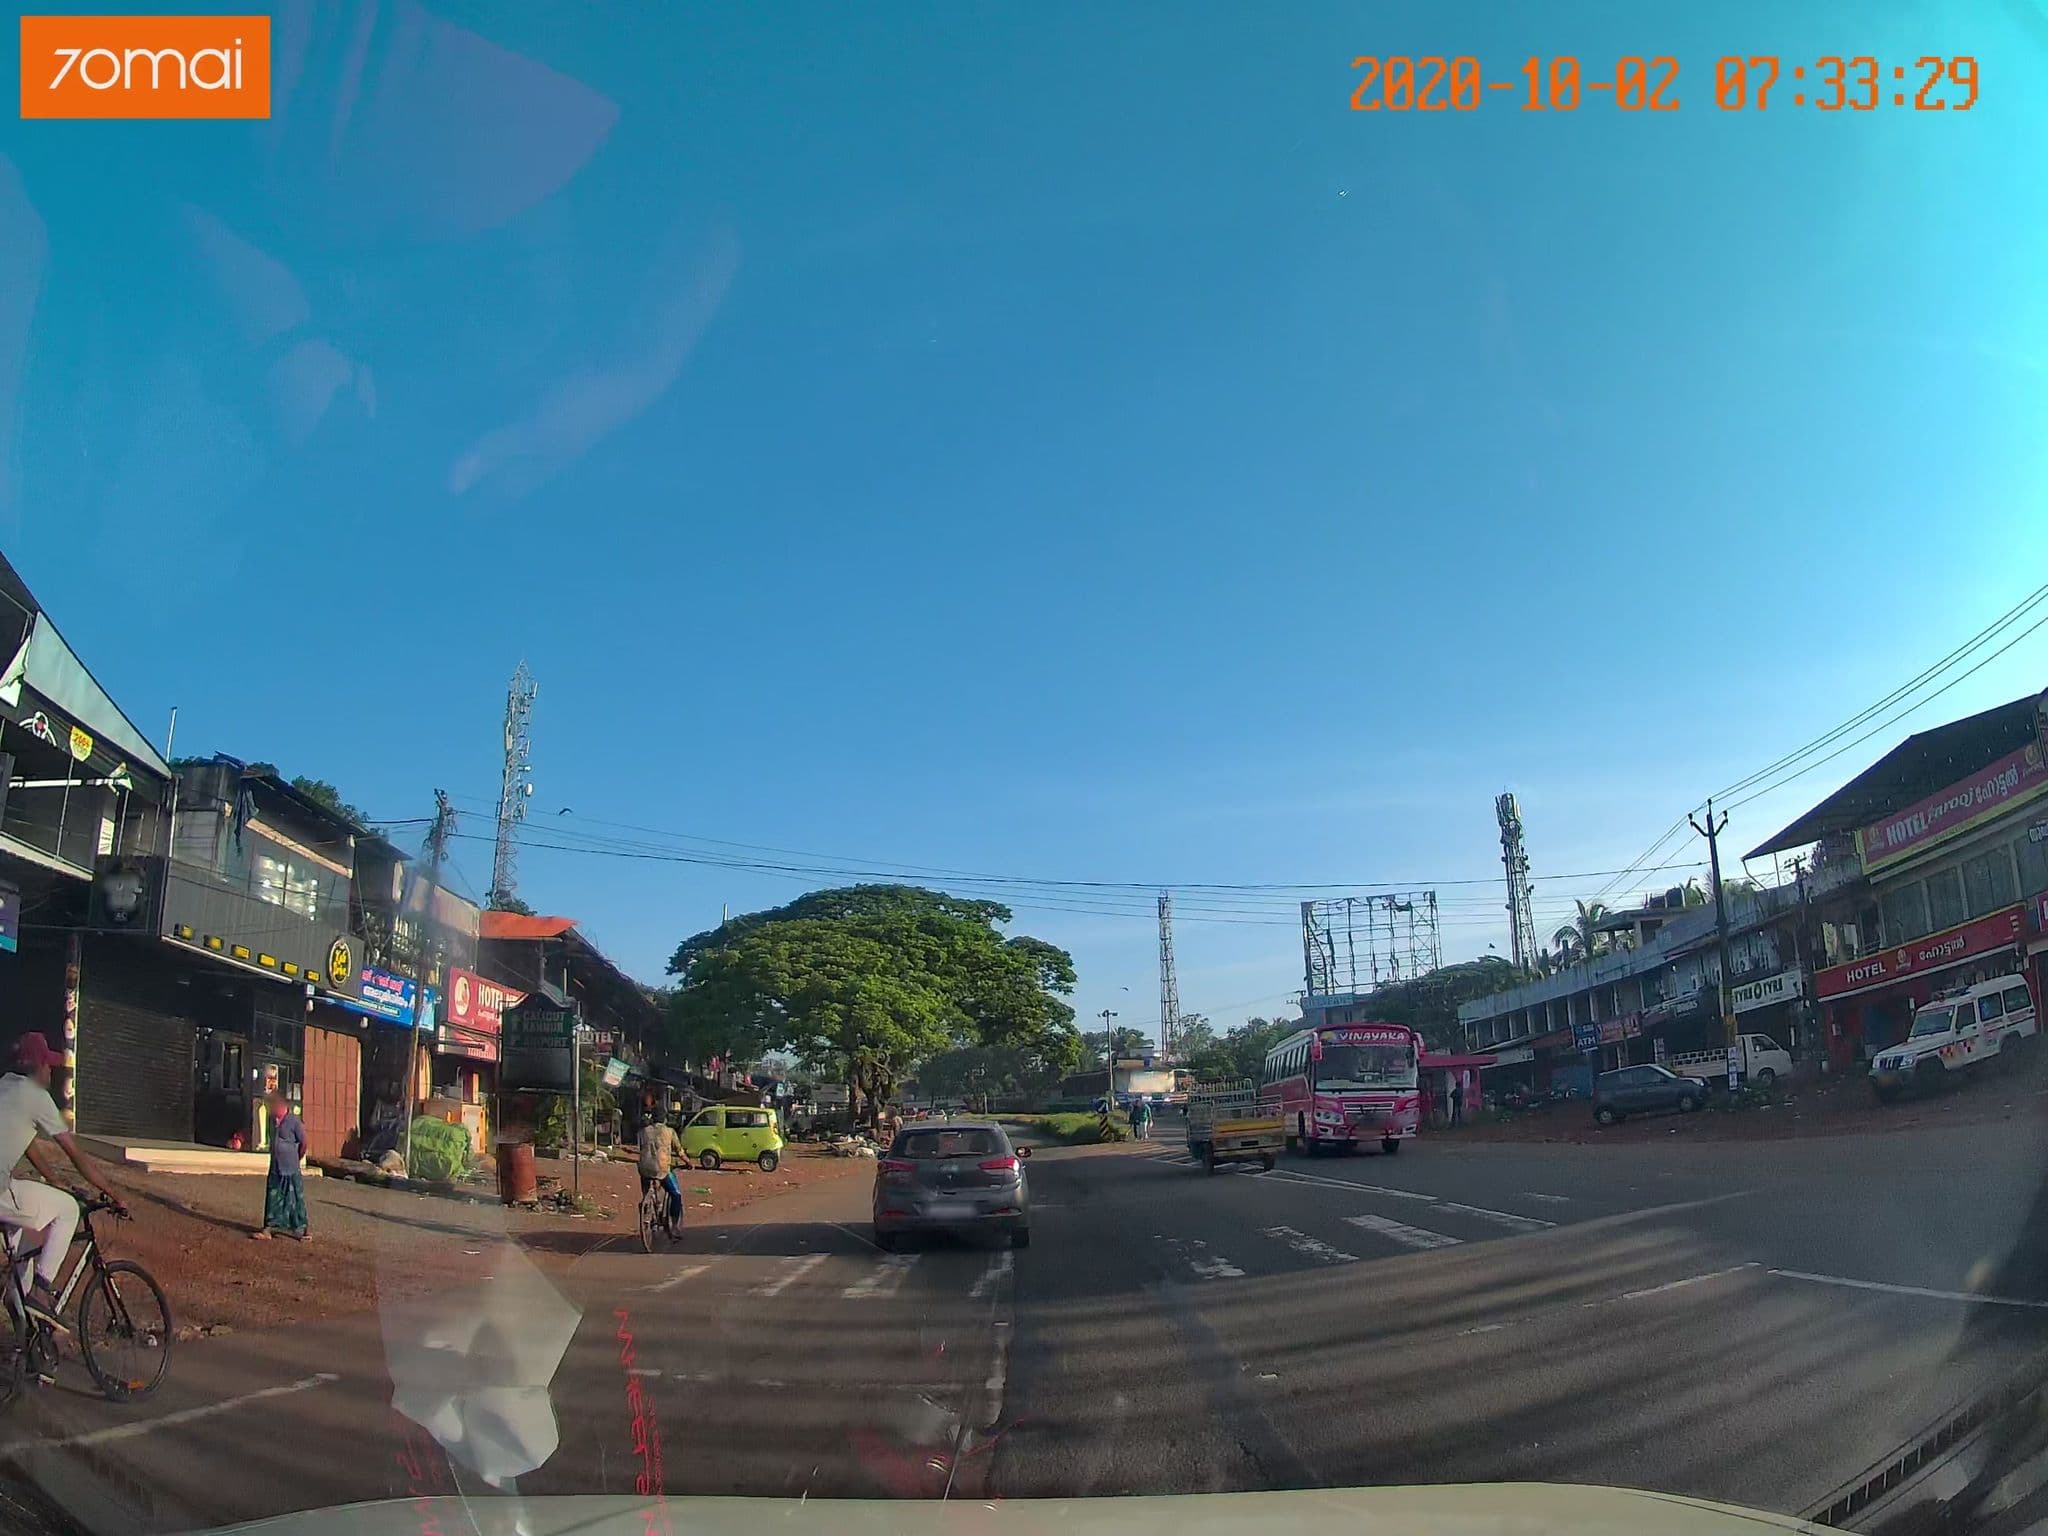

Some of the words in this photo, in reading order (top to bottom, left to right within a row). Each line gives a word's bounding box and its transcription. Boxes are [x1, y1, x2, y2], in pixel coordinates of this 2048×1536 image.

[1886, 811, 1929, 847] HOTEL
[1846, 961, 1887, 983] HOTEL
[1339, 1031, 1406, 1041] VINAYAKA
[1577, 1036, 1597, 1049] ATM
